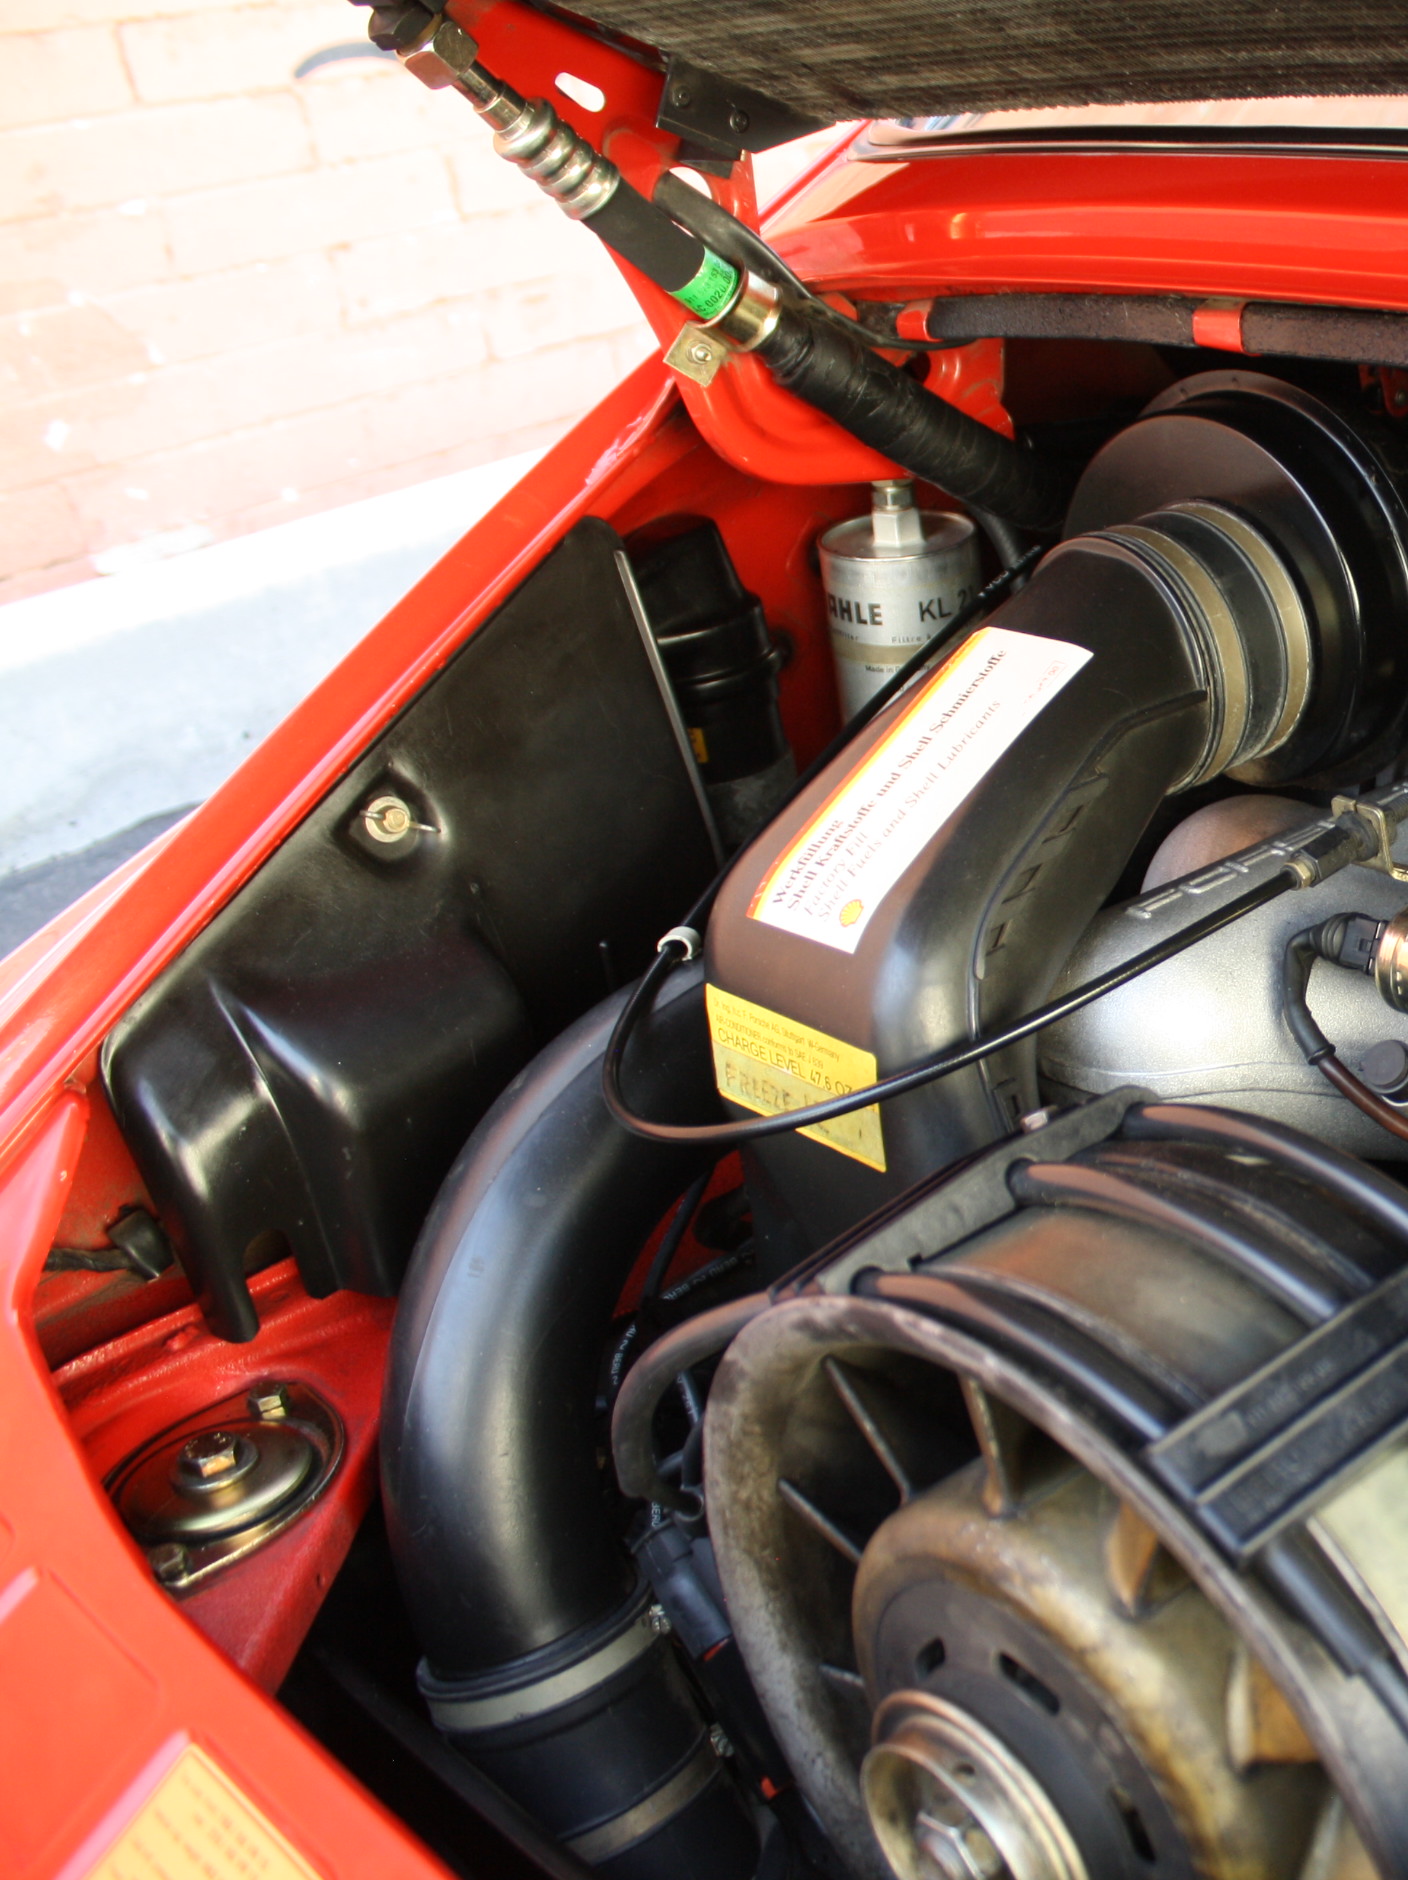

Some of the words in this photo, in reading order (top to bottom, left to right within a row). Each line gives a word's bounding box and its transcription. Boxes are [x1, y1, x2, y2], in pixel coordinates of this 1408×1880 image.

[828, 592, 883, 625] AHLE
[919, 598, 952, 622] KL
[865, 664, 884, 673] Made
[787, 870, 818, 911] Shell
[815, 799, 877, 867] Kraftstoffe
[876, 772, 902, 797] und
[897, 736, 933, 770] Shell
[929, 650, 1007, 734] Schmierstoffe
[817, 878, 848, 921] Shell
[846, 841, 882, 877] Fuels
[882, 808, 907, 838] and
[904, 772, 939, 809] Shell
[937, 700, 1003, 771] Lubricants
[772, 819, 844, 904] Werkfüllung
[718, 1027, 768, 1062] CHARGE
[768, 1049, 806, 1079] LEVEL
